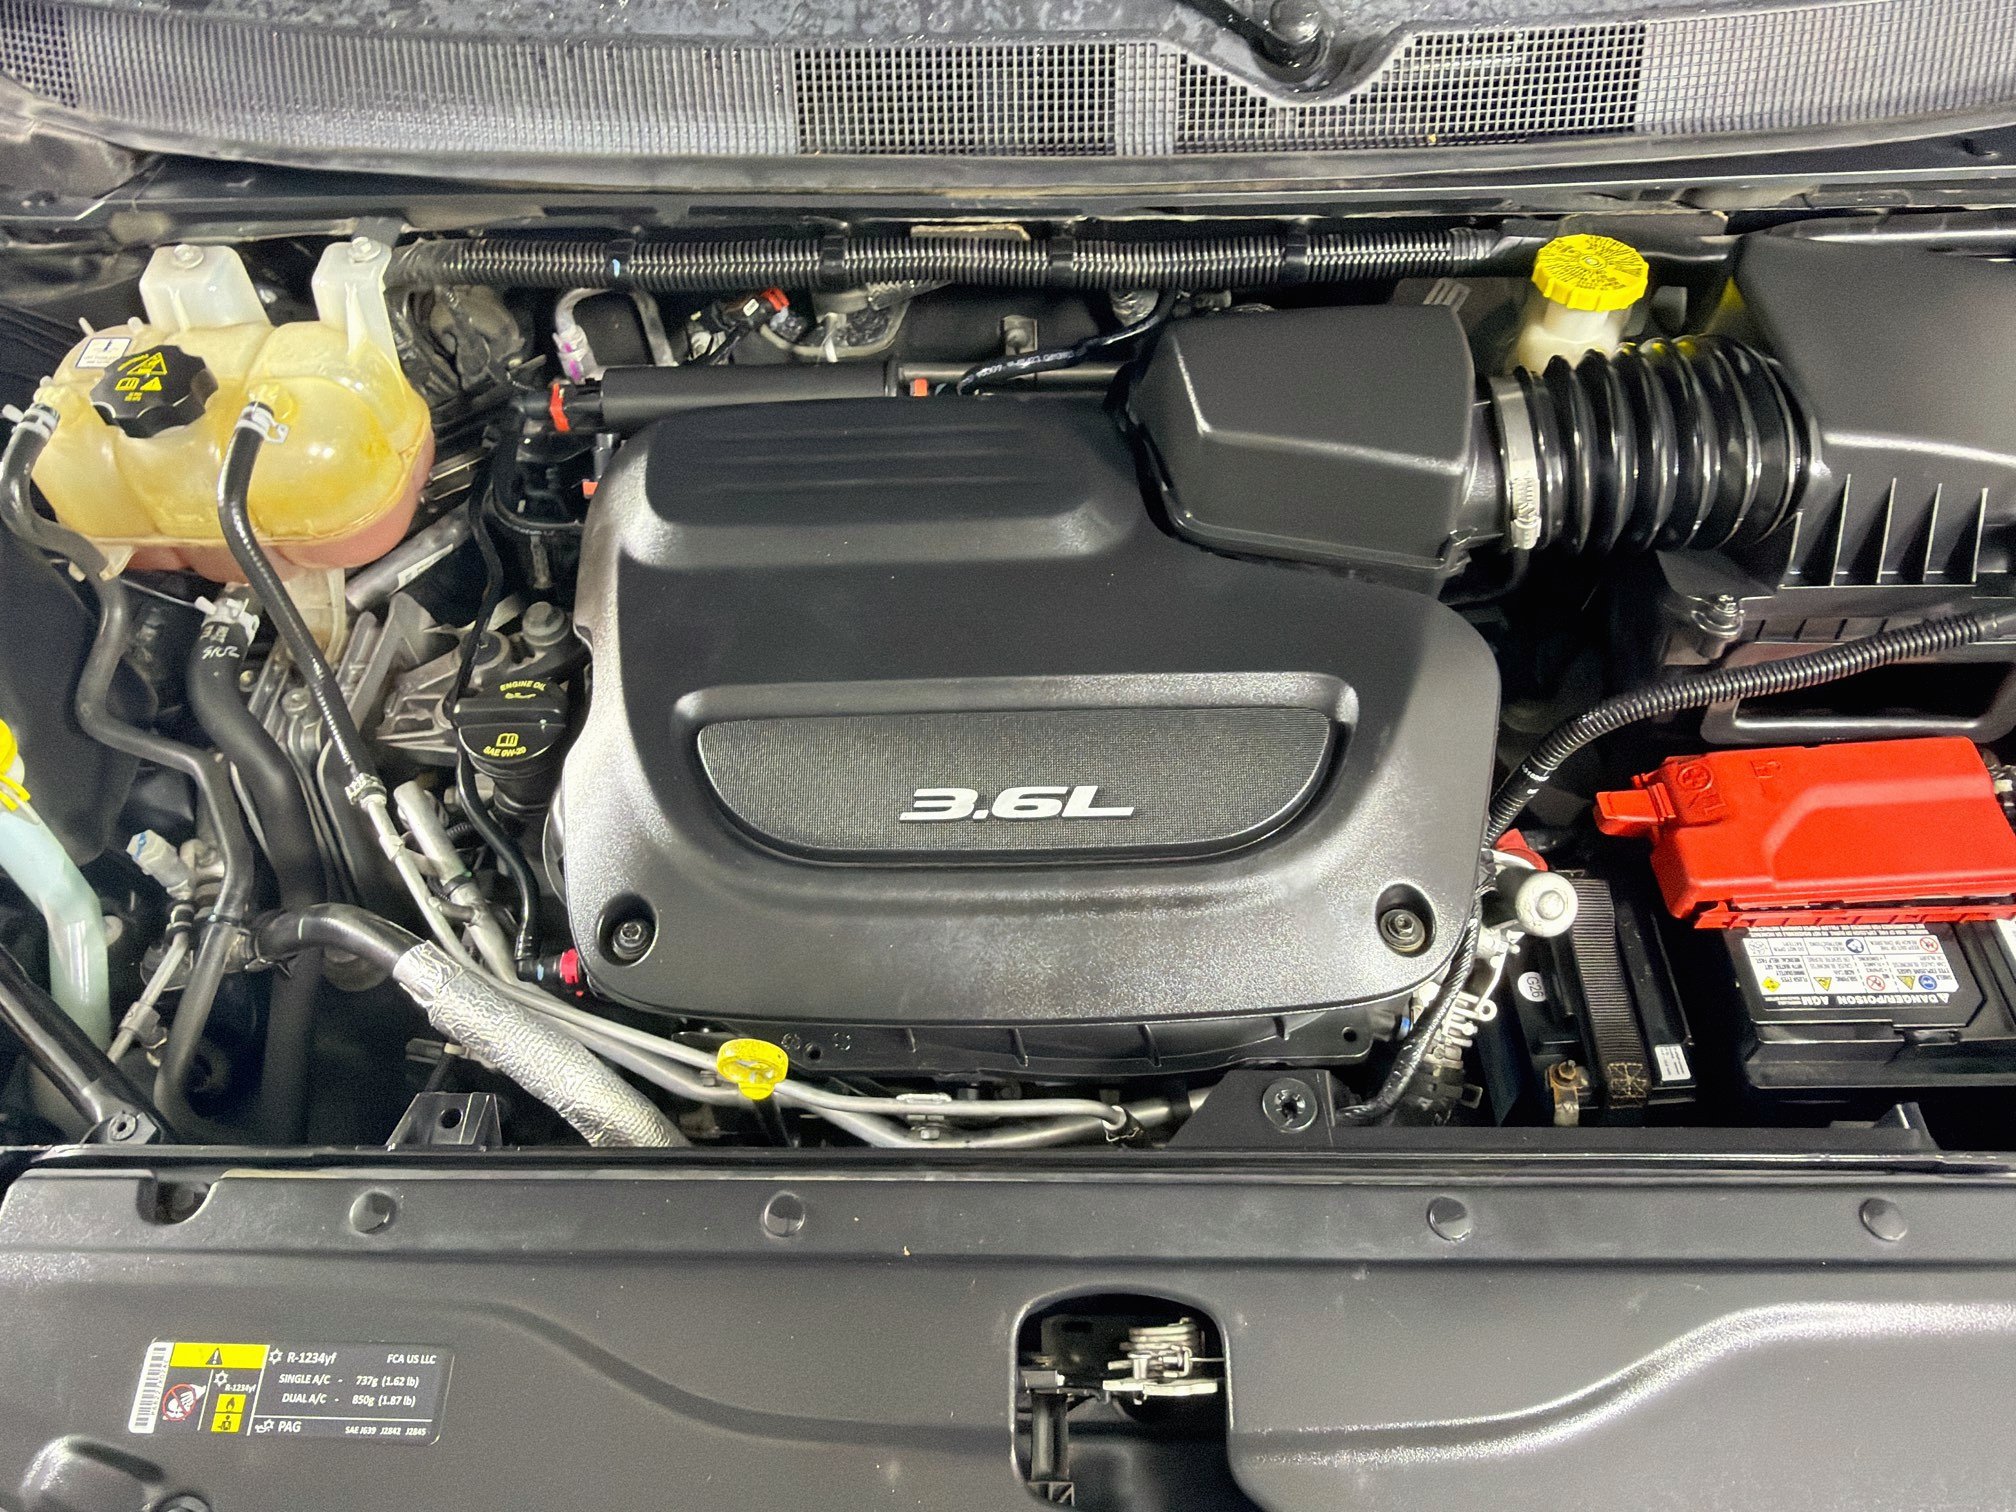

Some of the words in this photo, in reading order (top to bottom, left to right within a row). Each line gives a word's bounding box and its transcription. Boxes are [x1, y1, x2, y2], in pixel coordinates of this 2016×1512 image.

[500, 681, 534, 692] ENGINE
[533, 681, 546, 692] OIL
[483, 745, 501, 757] SAE
[501, 746, 527, 757] 0W-20
[899, 785, 1135, 821] 3.6L
[1526, 976, 1544, 998] G26
[1836, 994, 1939, 1005] DANGER/POISON
[286, 1351, 338, 1367] R-1234yf
[386, 1353, 405, 1364] FCA
[406, 1354, 420, 1364] US
[420, 1354, 437, 1365] LLC
[278, 1373, 312, 1384] SINGLE
[311, 1373, 331, 1386] A/C
[356, 1375, 379, 1388] 737g
[381, 1376, 406, 1388] (1.62
[406, 1376, 420, 1389] lb)
[224, 1383, 257, 1394] R-1234yf
[281, 1393, 308, 1403] DUAL
[308, 1392, 328, 1405] A/C
[352, 1394, 376, 1407] 850g
[378, 1395, 402, 1407] (1.87
[402, 1395, 416, 1408] lb)
[277, 1420, 302, 1433] PAG
[345, 1425, 360, 1434] SAE
